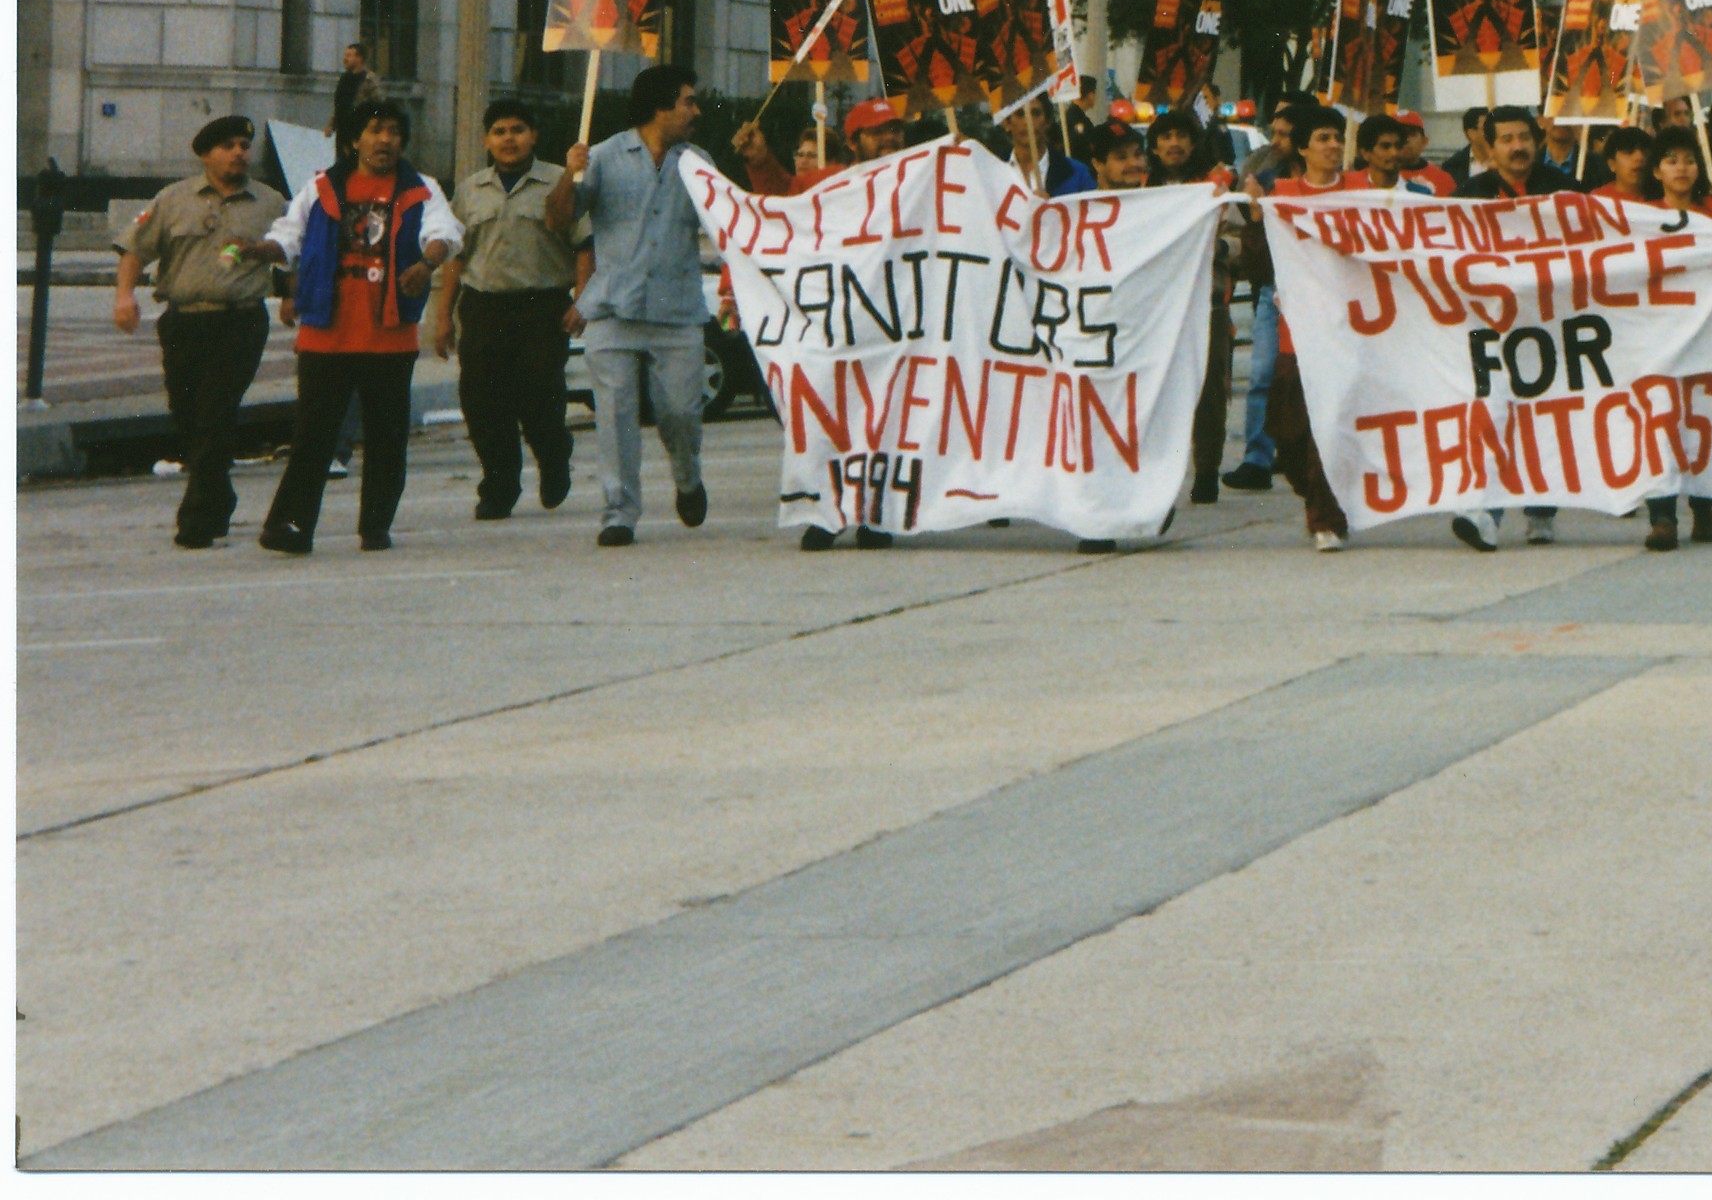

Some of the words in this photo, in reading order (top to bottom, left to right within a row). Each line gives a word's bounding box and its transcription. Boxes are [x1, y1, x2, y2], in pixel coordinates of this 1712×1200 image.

[1195, 10, 1222, 35] ONE
[1609, 3, 1642, 31] ONE
[996, 183, 1121, 271] FOR
[1274, 192, 1632, 256] CONVENCION
[1347, 235, 1697, 335] JUSTICE
[1468, 314, 1614, 398] FOR
[828, 451, 923, 531] 1994
